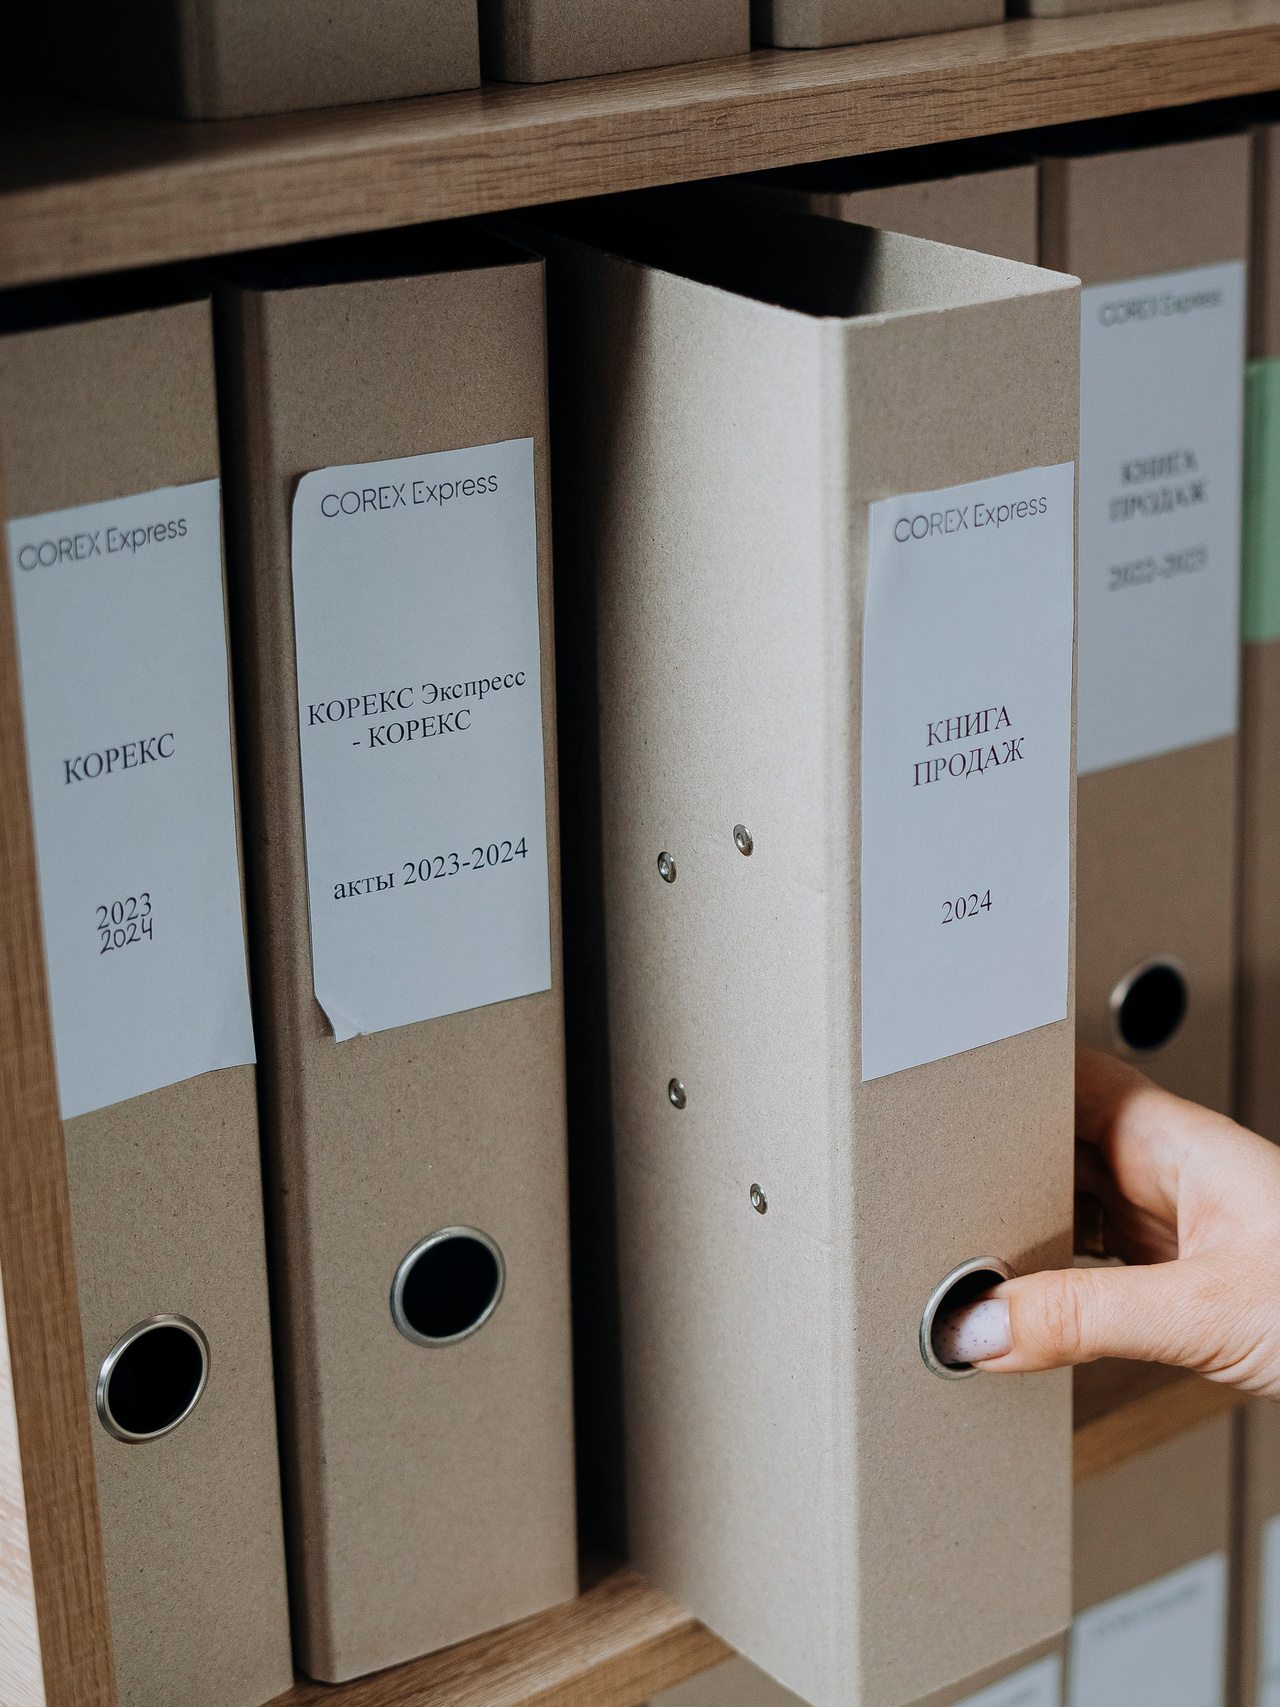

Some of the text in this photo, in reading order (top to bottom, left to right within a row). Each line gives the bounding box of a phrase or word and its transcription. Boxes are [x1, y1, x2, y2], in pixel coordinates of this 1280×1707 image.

[321, 474, 499, 518] COREX Express
[893, 496, 1048, 544] COREX Express
[18, 518, 187, 572] COREX Express
[306, 670, 527, 727] КОРЕКС Экспресс
[367, 709, 472, 749] КОРЕКС
[926, 705, 1013, 748] КНИГА
[62, 732, 175, 786] КОРЕКС
[912, 736, 1025, 788] ПРОДАЖ
[333, 836, 529, 900] акты 2023-2024
[96, 893, 152, 931] 2023
[941, 888, 993, 925] 2024
[100, 918, 153, 956] 2024
